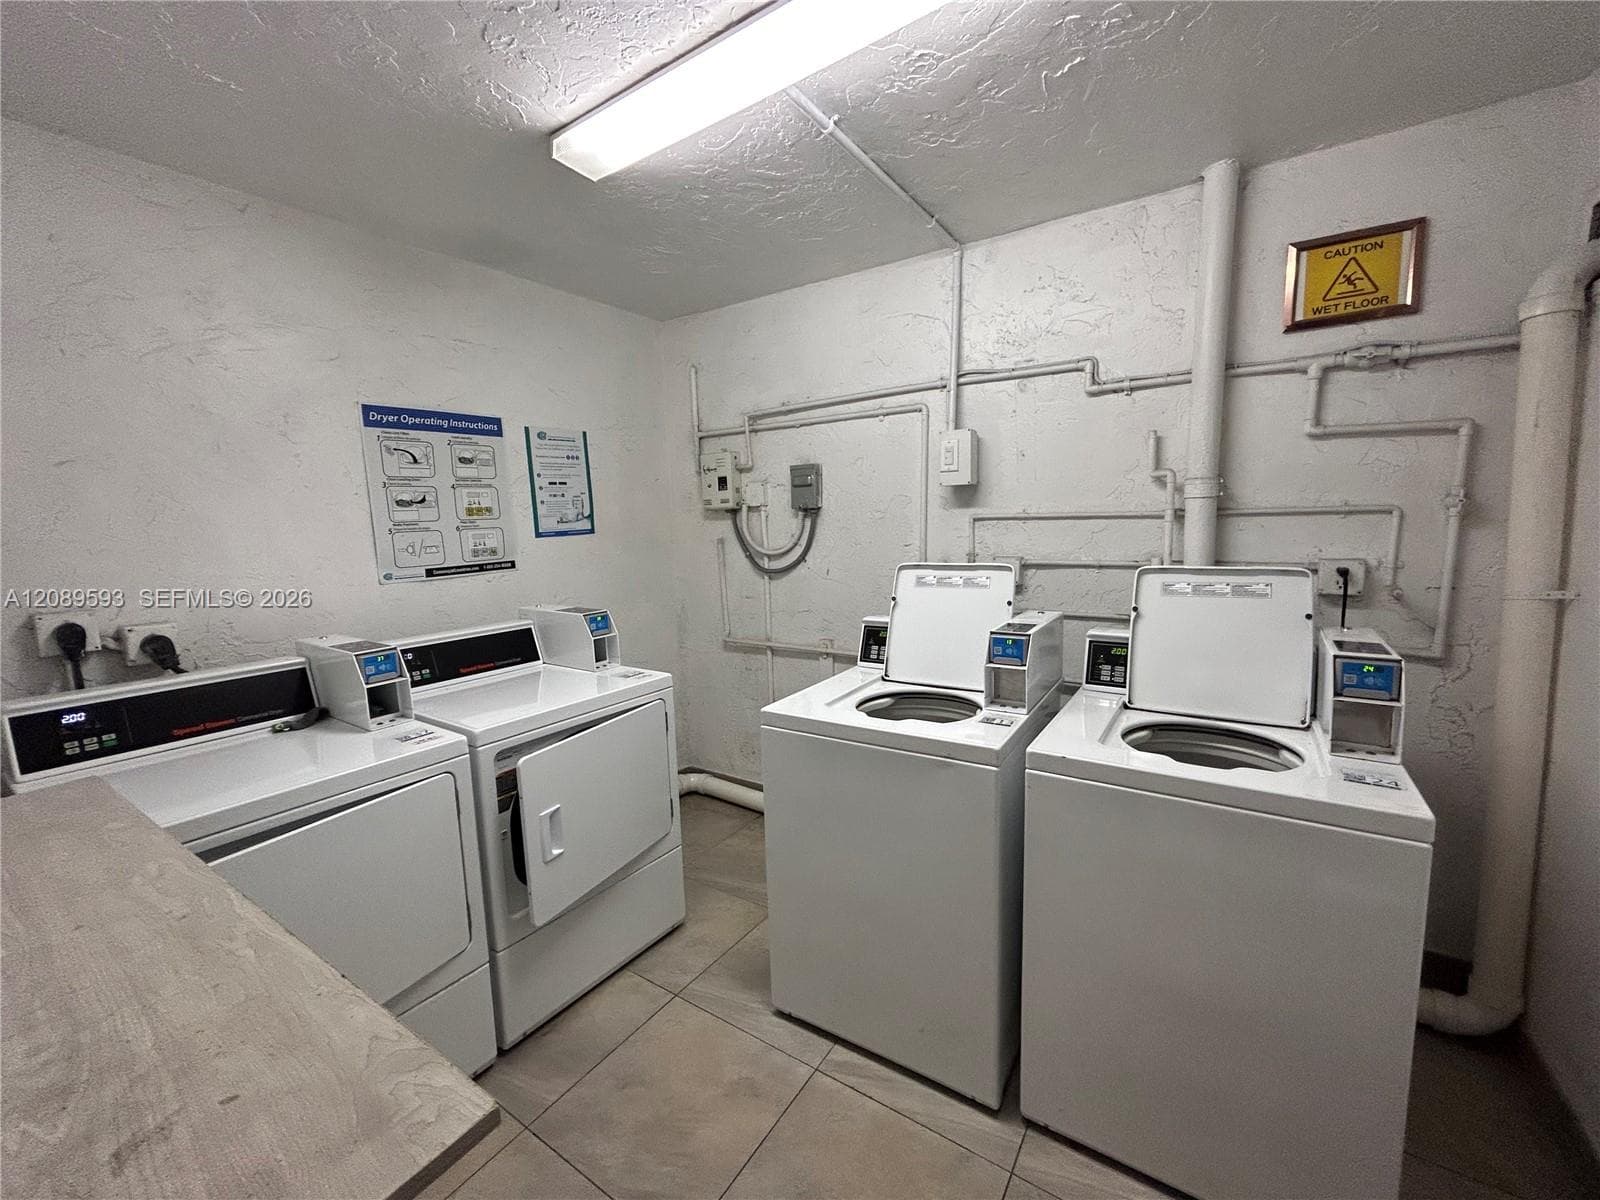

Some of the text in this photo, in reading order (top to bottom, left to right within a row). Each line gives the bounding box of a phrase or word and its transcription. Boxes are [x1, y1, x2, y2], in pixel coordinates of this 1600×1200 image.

[1324, 240, 1384, 260] CAUTION
[1311, 295, 1390, 316] WET FLOOR
[369, 411, 498, 431] Dryer Operating Instructions
[1362, 665, 1375, 673] 24
